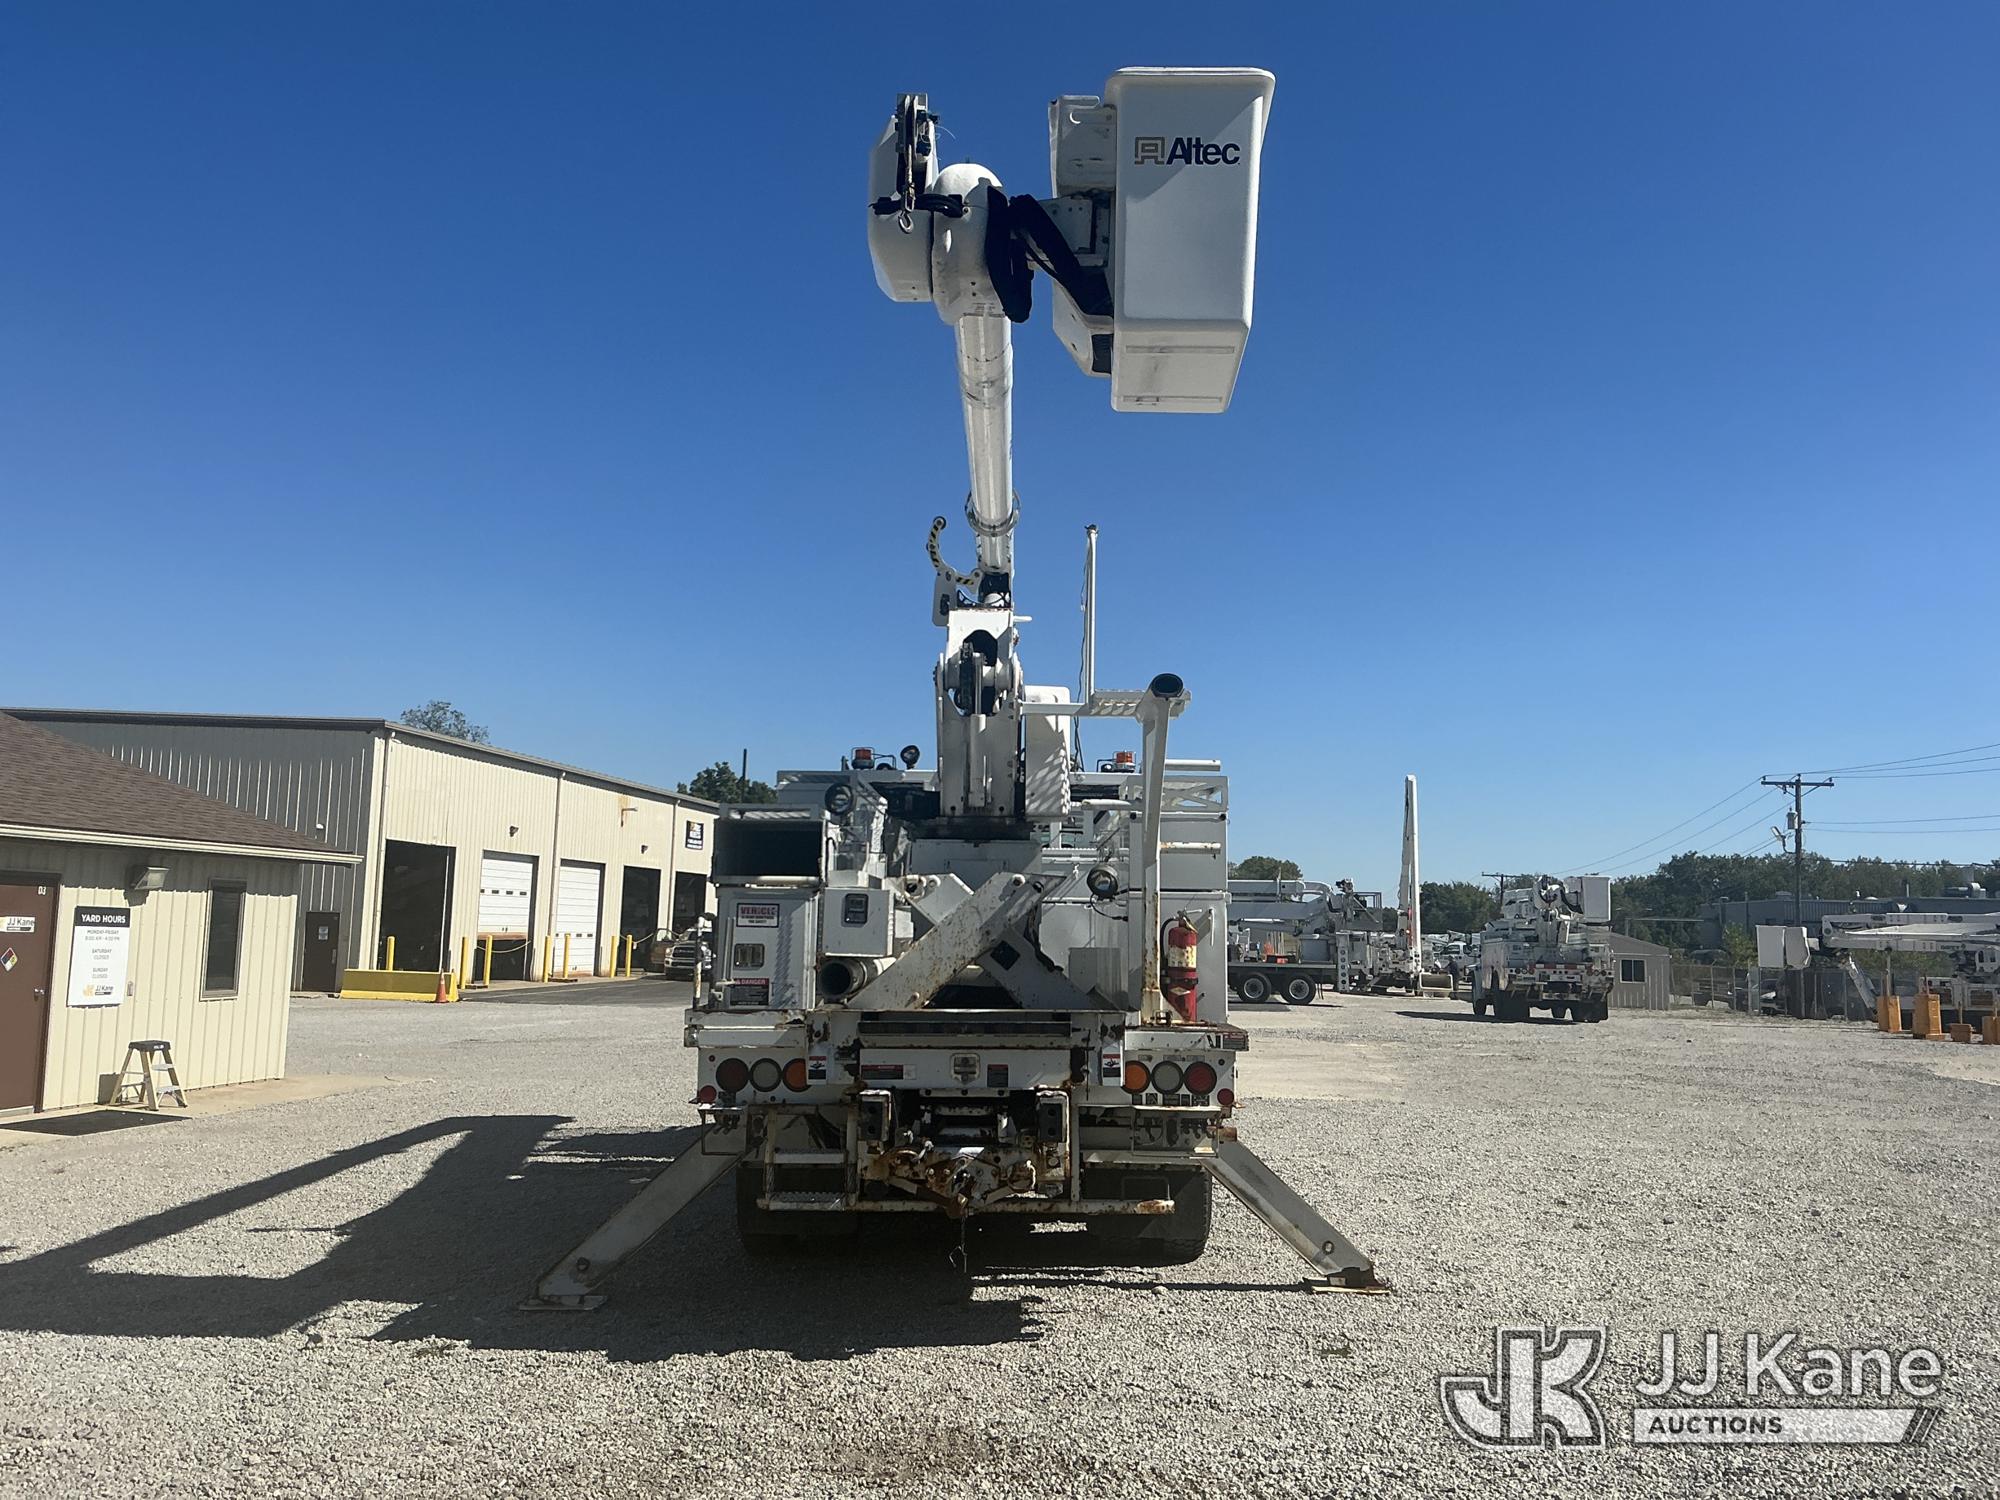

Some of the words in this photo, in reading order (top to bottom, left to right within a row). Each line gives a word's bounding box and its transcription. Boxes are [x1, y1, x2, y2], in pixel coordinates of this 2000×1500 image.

[1166, 136, 1240, 165] Altec
[7, 918, 16, 926] JJ
[17, 918, 35, 926] Kane
[81, 914, 101, 922] YARD
[102, 915, 126, 923] HOURS
